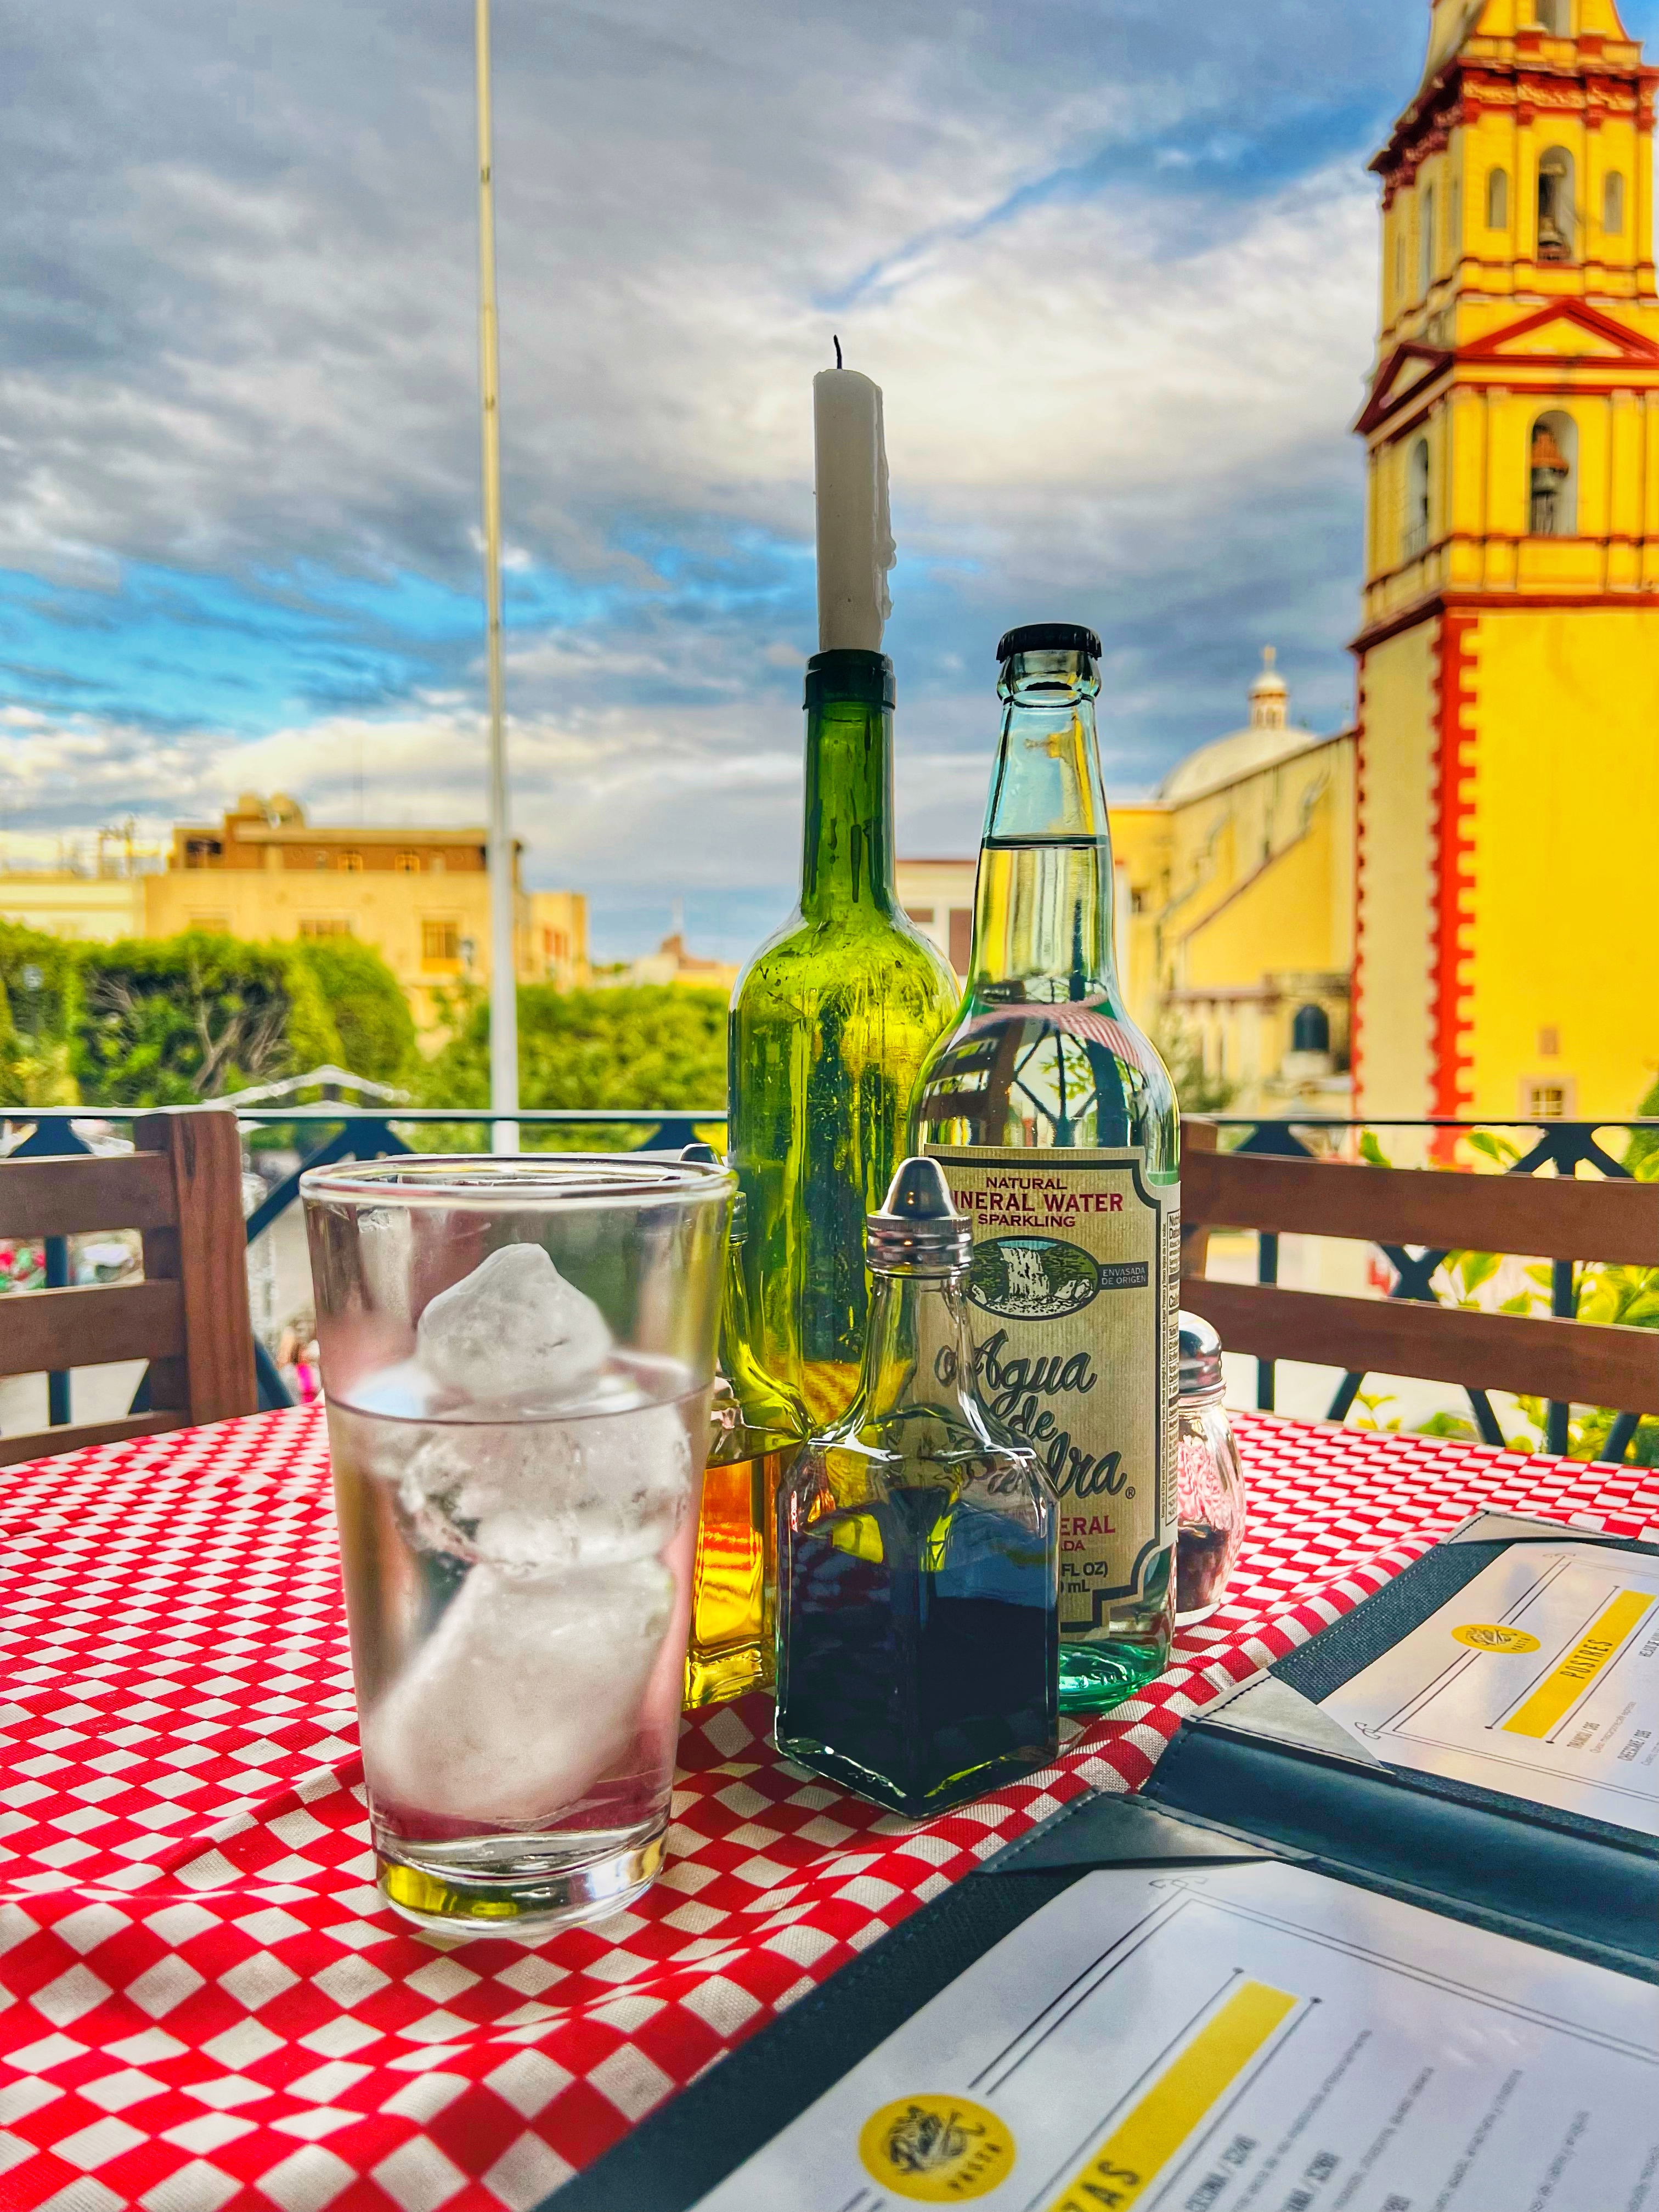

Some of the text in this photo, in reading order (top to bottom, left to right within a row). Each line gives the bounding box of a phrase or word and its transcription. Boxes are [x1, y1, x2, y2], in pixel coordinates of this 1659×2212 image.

[986, 1177, 1068, 1190] NATURAL
[953, 1190, 1123, 1212] INERAL WATER
[978, 1214, 1076, 1228] SPARKLING
[1103, 1267, 1146, 1277] ENVASADA
[1116, 1275, 1146, 1284] ORIGEN
[974, 1328, 1097, 1419] Agua
[1008, 1395, 1058, 1441] de
[1062, 1561, 1108, 1578] FL OZ)
[1068, 1579, 1090, 1592] mL
[1559, 1639, 1612, 1679] POSTRES
